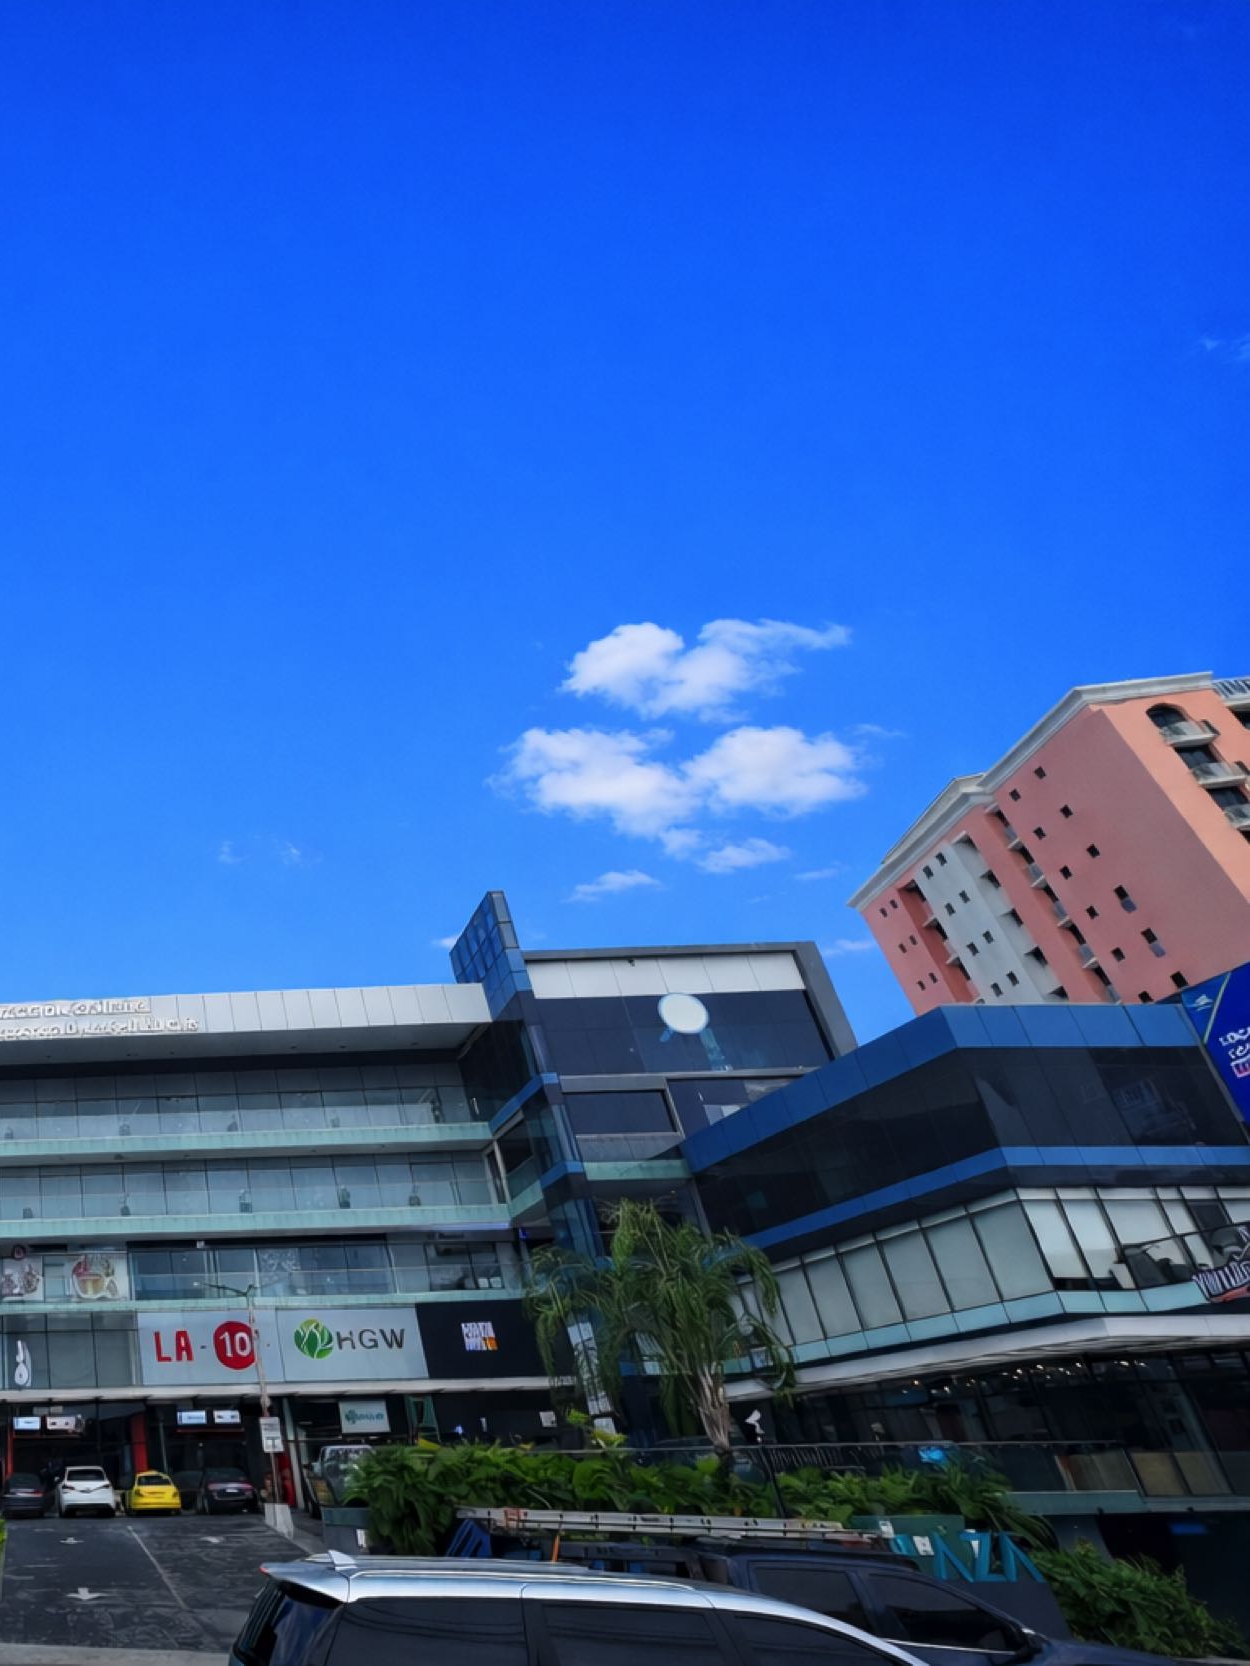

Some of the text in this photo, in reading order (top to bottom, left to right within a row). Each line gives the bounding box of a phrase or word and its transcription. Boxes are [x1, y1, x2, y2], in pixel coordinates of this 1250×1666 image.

[154, 1330, 250, 1362] LA 10
[336, 1328, 405, 1351] HGW
